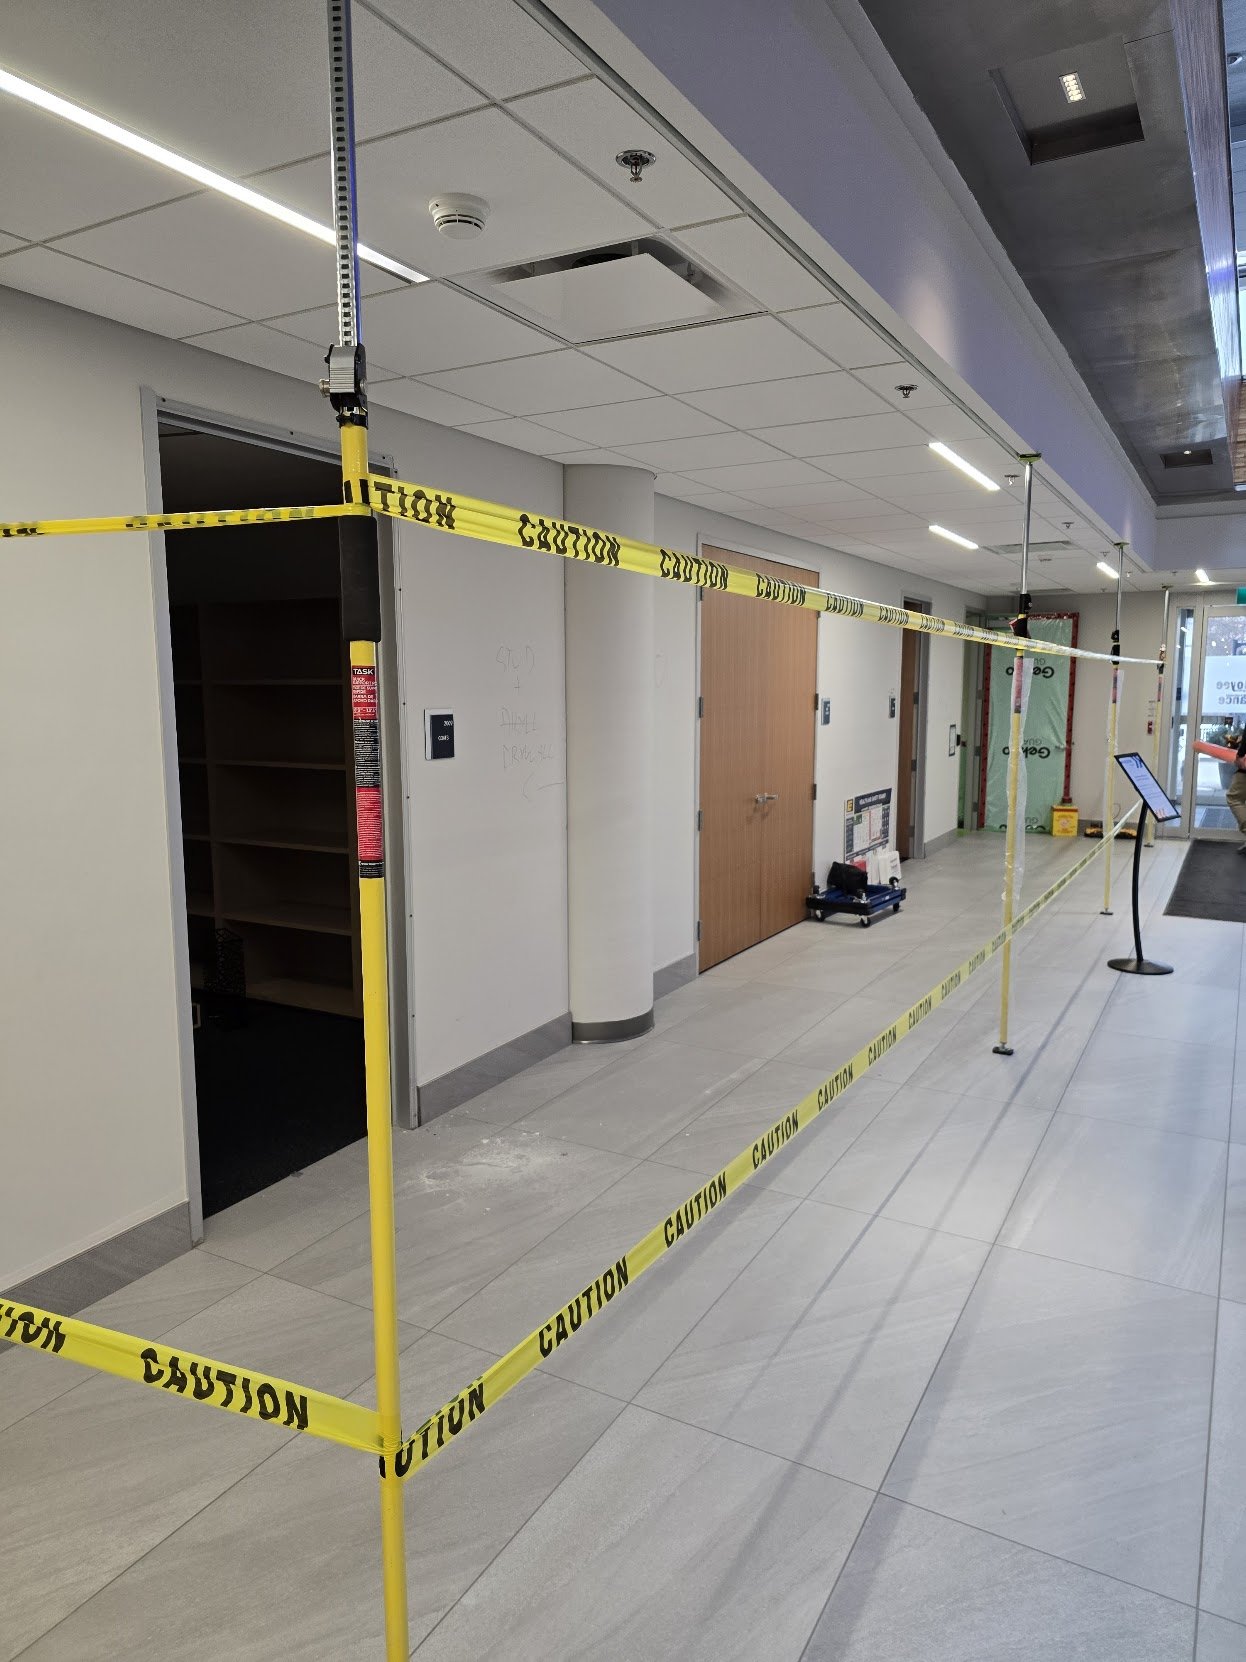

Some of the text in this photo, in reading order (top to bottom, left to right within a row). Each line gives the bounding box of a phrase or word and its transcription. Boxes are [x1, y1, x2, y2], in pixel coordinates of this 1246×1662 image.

[518, 514, 621, 567] CAUTION
[660, 548, 729, 590] CAUTION
[756, 573, 807, 607] CAUTION
[825, 593, 864, 617] CAUTION
[1005, 666, 1055, 679] Geo
[1002, 746, 1051, 759] Geko
[538, 1255, 630, 1359] CAUTION
[663, 1171, 727, 1248] CAUTION
[752, 1109, 799, 1170] CAUTION
[817, 1063, 854, 1112] CAUTION
[868, 1025, 897, 1066] CAUTION
[909, 996, 932, 1031] CAUTION
[941, 971, 961, 1000] CAUTION
[0, 1303, 309, 1430] ION CAUTION
